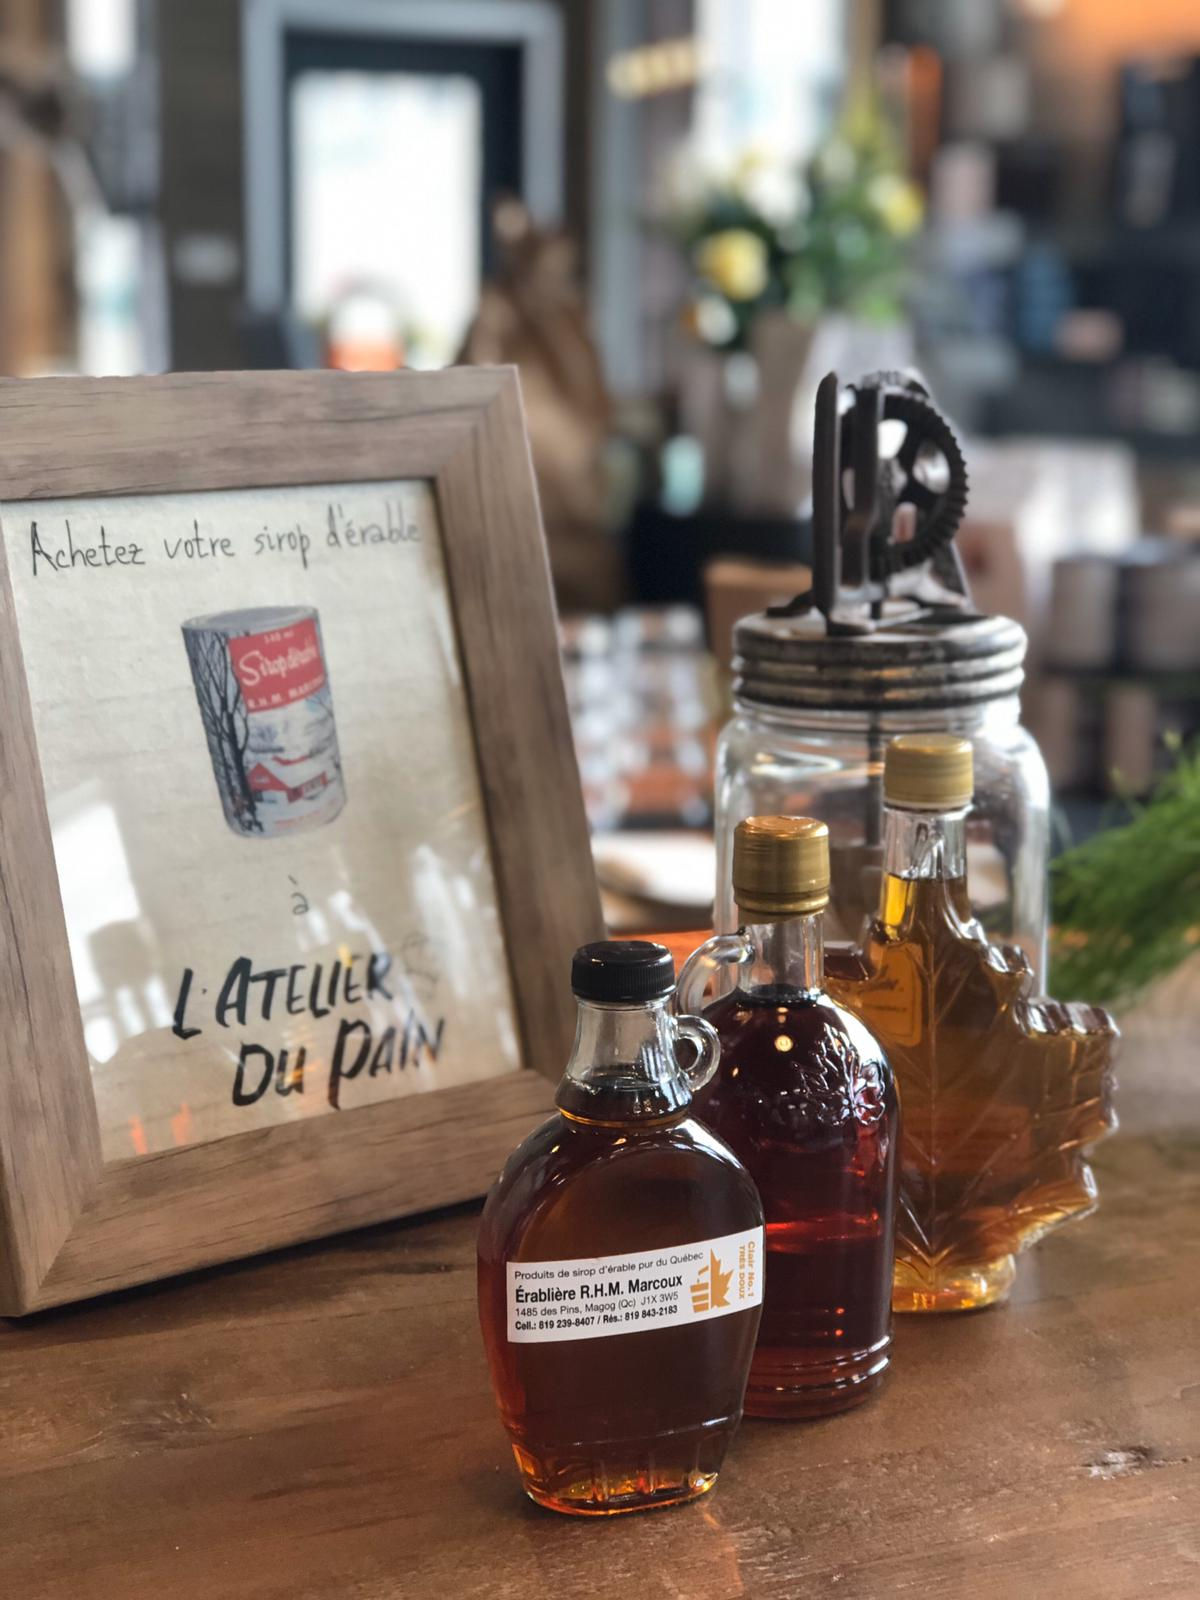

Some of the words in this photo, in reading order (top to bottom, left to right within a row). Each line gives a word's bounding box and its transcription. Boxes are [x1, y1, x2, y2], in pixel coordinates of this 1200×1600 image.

[31, 520, 145, 576] Achetez
[164, 519, 235, 560] votre
[254, 524, 311, 569] sirop
[327, 504, 422, 549] d'érable
[288, 874, 309, 915] à
[231, 1041, 307, 1107] DU
[328, 1008, 445, 1111] PAIN
[515, 1270, 555, 1280] Produits
[557, 1268, 570, 1278] de
[572, 1267, 596, 1277] sirop
[598, 1263, 636, 1275] d'érable
[638, 1260, 654, 1271] pur
[656, 1257, 668, 1267] du
[670, 1252, 704, 1265] Québec
[748, 1241, 756, 1268] Clair
[515, 1285, 577, 1303] Érablière
[580, 1281, 624, 1299] R.H.M.
[628, 1275, 683, 1294] Marcoux
[516, 1307, 538, 1317] 1485
[540, 1306, 558, 1316] des
[585, 1302, 616, 1313] Magog
[618, 1298, 636, 1309] (Qc)
[640, 1295, 658, 1306] J1X
[659, 1291, 679, 1303] 3W5
[539, 1320, 555, 1330] 819
[556, 1316, 595, 1328] 239-8407
[625, 1311, 640, 1321] 819
[641, 1305, 678, 1319] 843-2183
